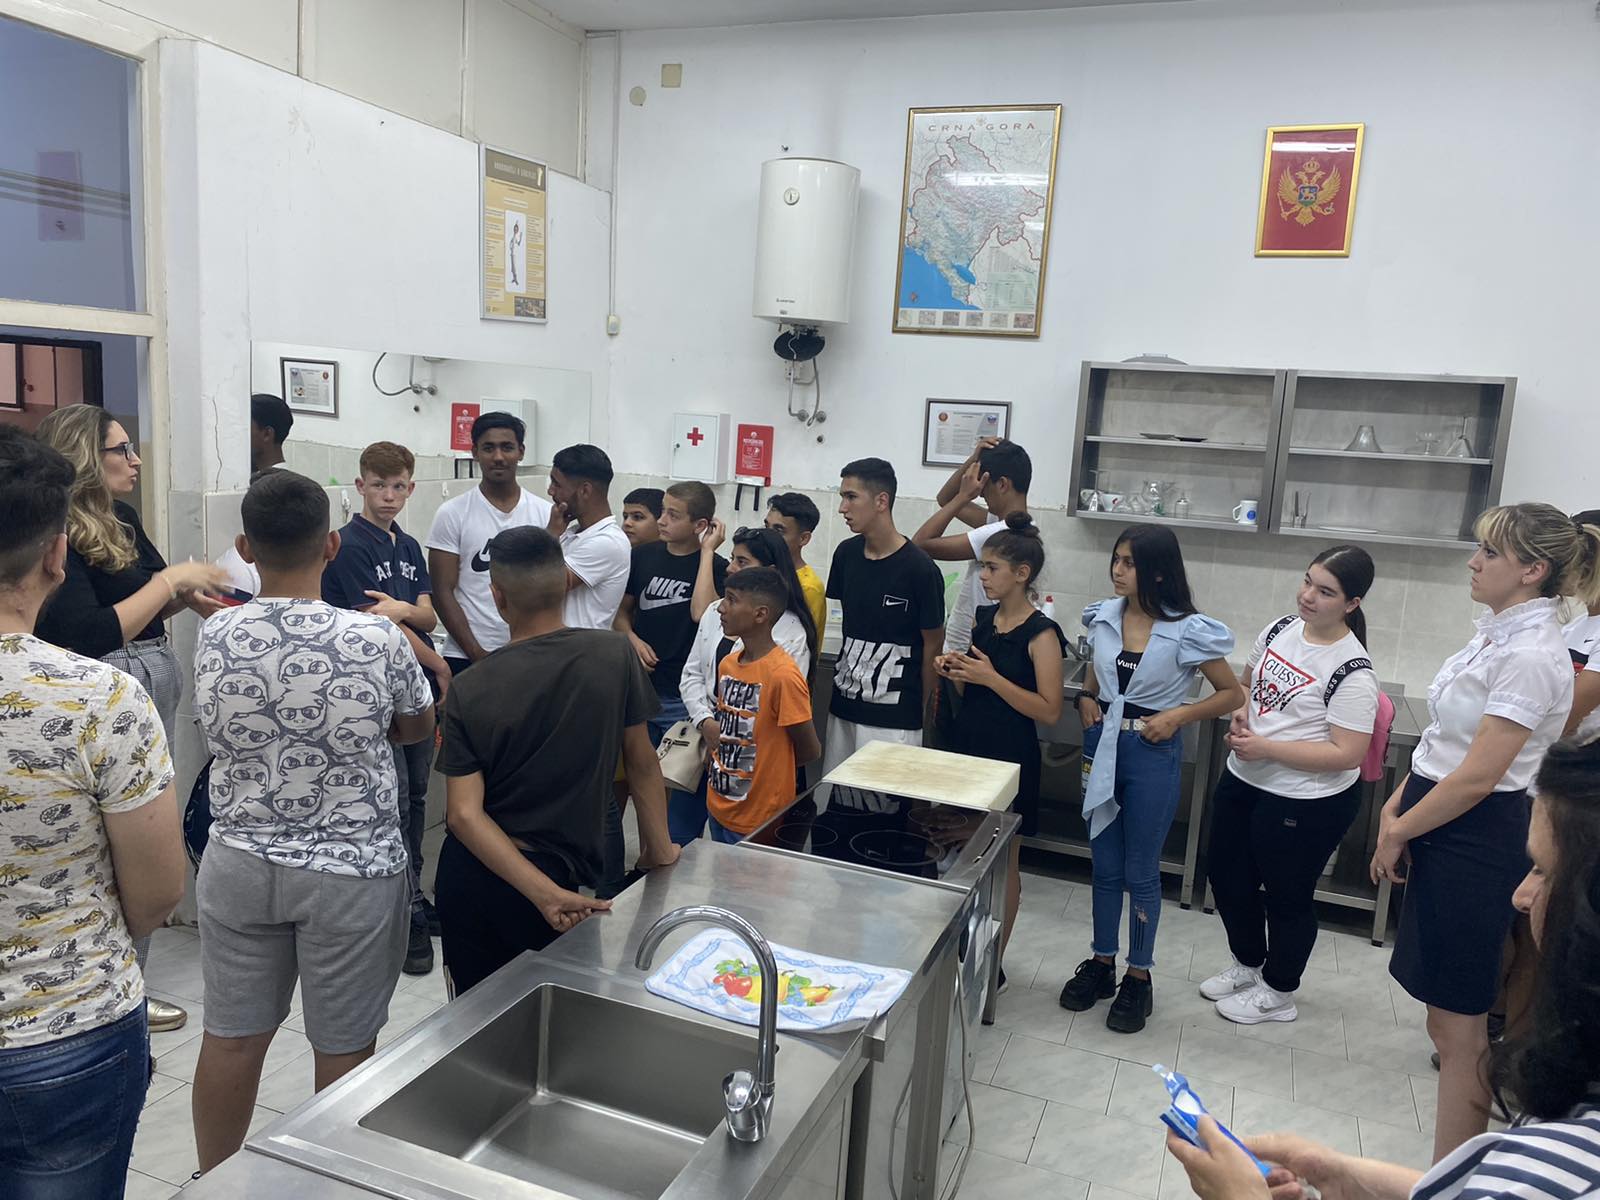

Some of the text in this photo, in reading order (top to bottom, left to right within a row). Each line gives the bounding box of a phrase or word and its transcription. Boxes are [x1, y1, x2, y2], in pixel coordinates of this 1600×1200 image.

[928, 122, 1035, 132] CRNA GORA
[646, 576, 691, 600] NIKE
[834, 637, 912, 705] NIKE
[1264, 659, 1301, 687] GUESS
